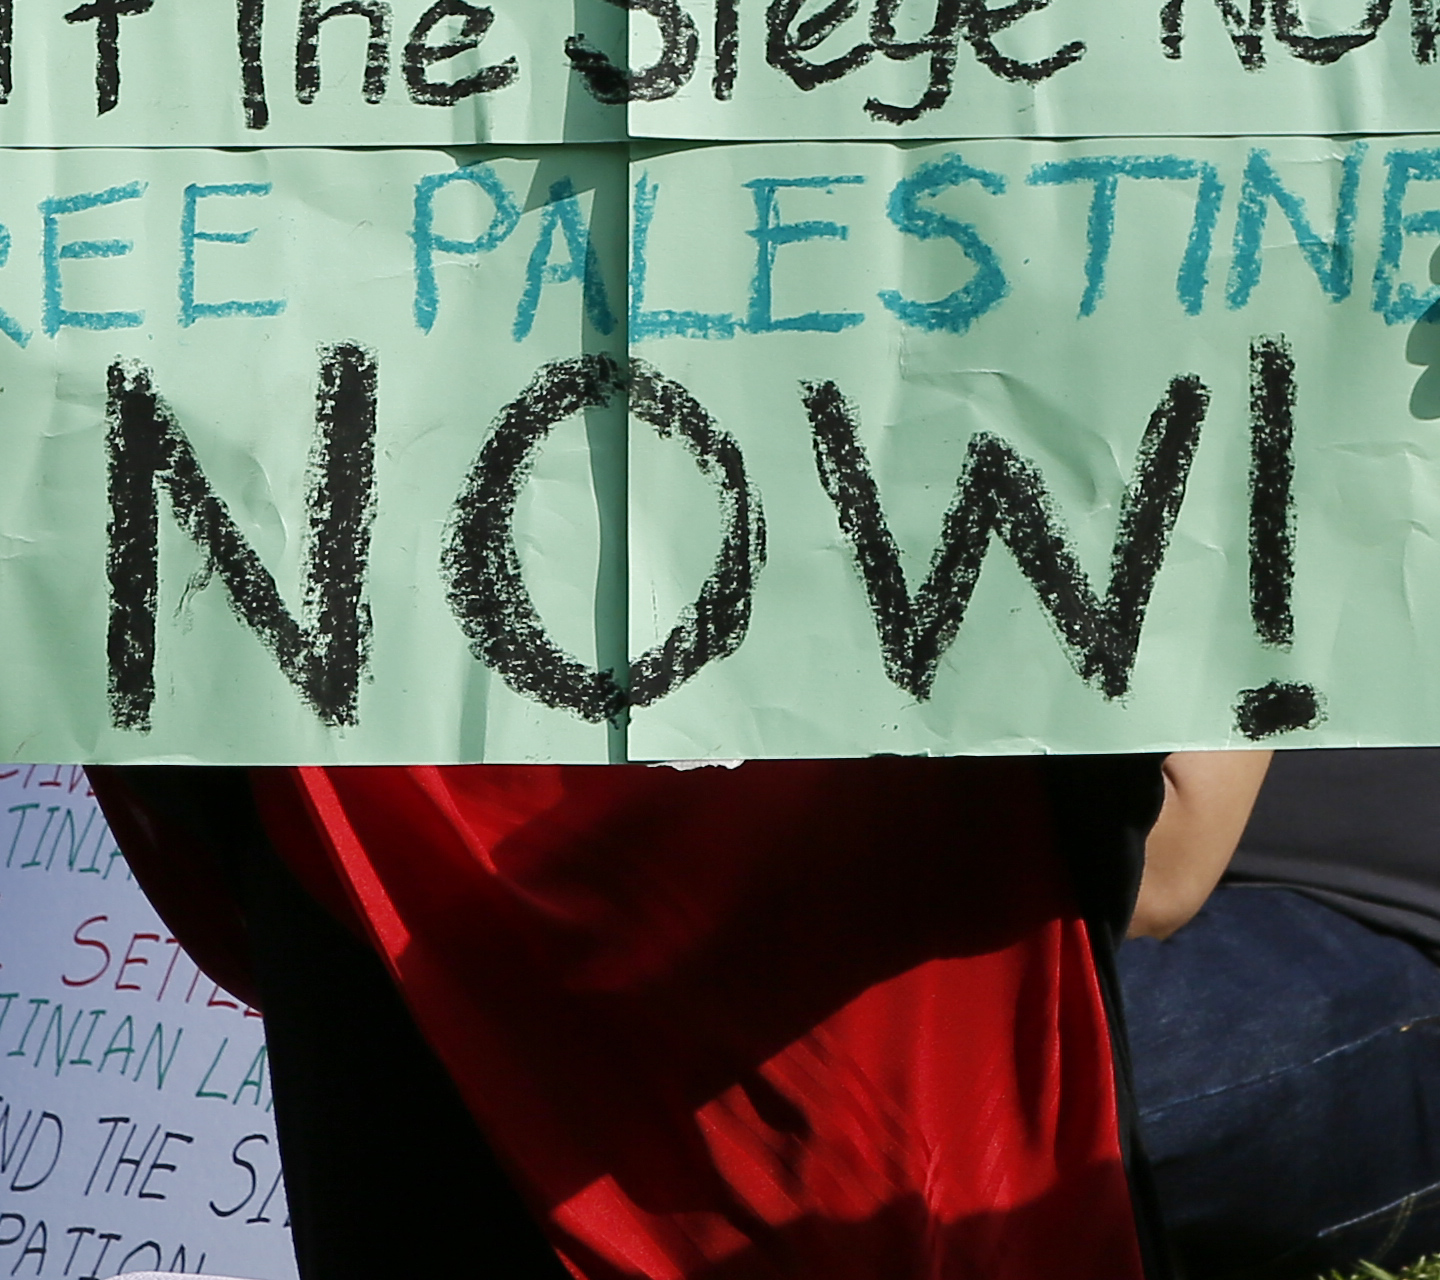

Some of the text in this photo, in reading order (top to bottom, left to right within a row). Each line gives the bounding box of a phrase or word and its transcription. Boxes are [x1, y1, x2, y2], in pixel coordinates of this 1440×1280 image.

[106, 335, 1320, 744] NOW!
[195, 1037, 275, 1114] LA
[83, 1116, 194, 1200] THE
